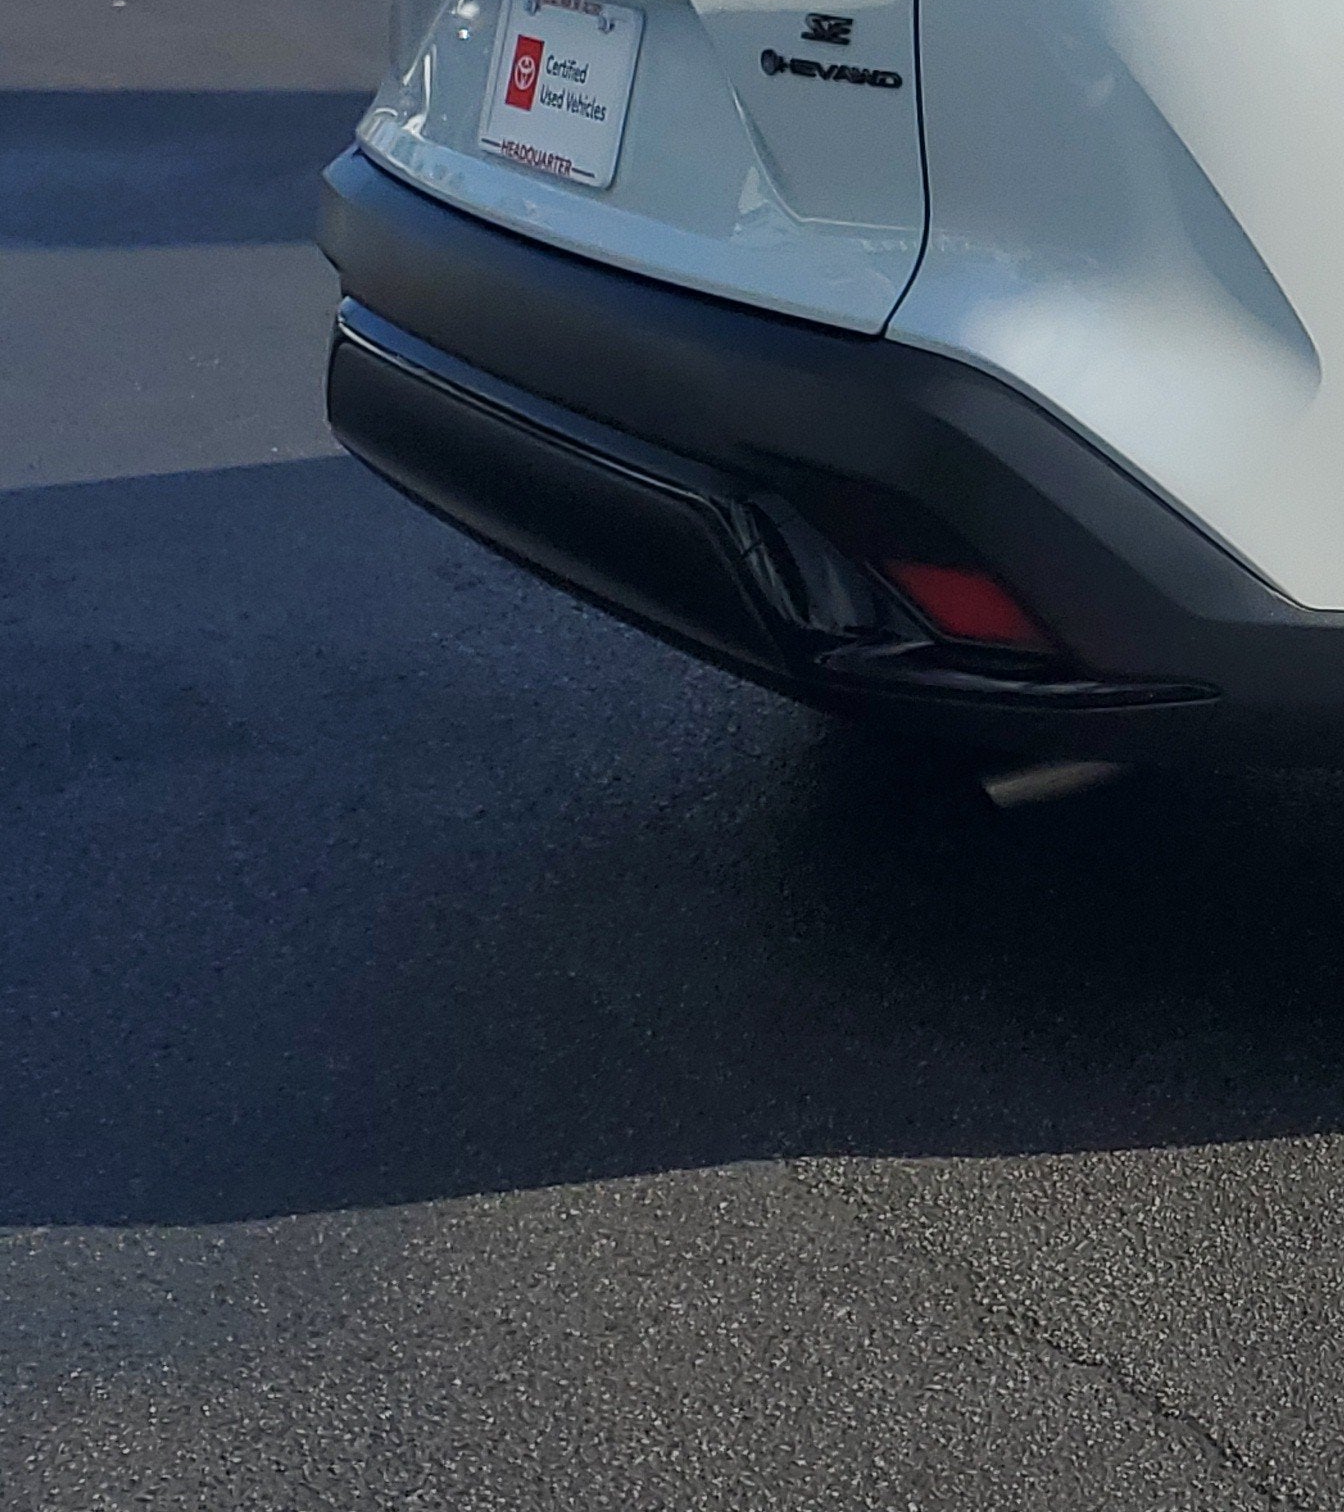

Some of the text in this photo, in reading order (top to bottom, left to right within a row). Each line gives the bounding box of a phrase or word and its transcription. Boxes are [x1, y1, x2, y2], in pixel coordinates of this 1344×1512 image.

[546, 54, 590, 84] Certified
[539, 84, 607, 122] Used Vehicles
[501, 138, 573, 176] HEADQUARTER
